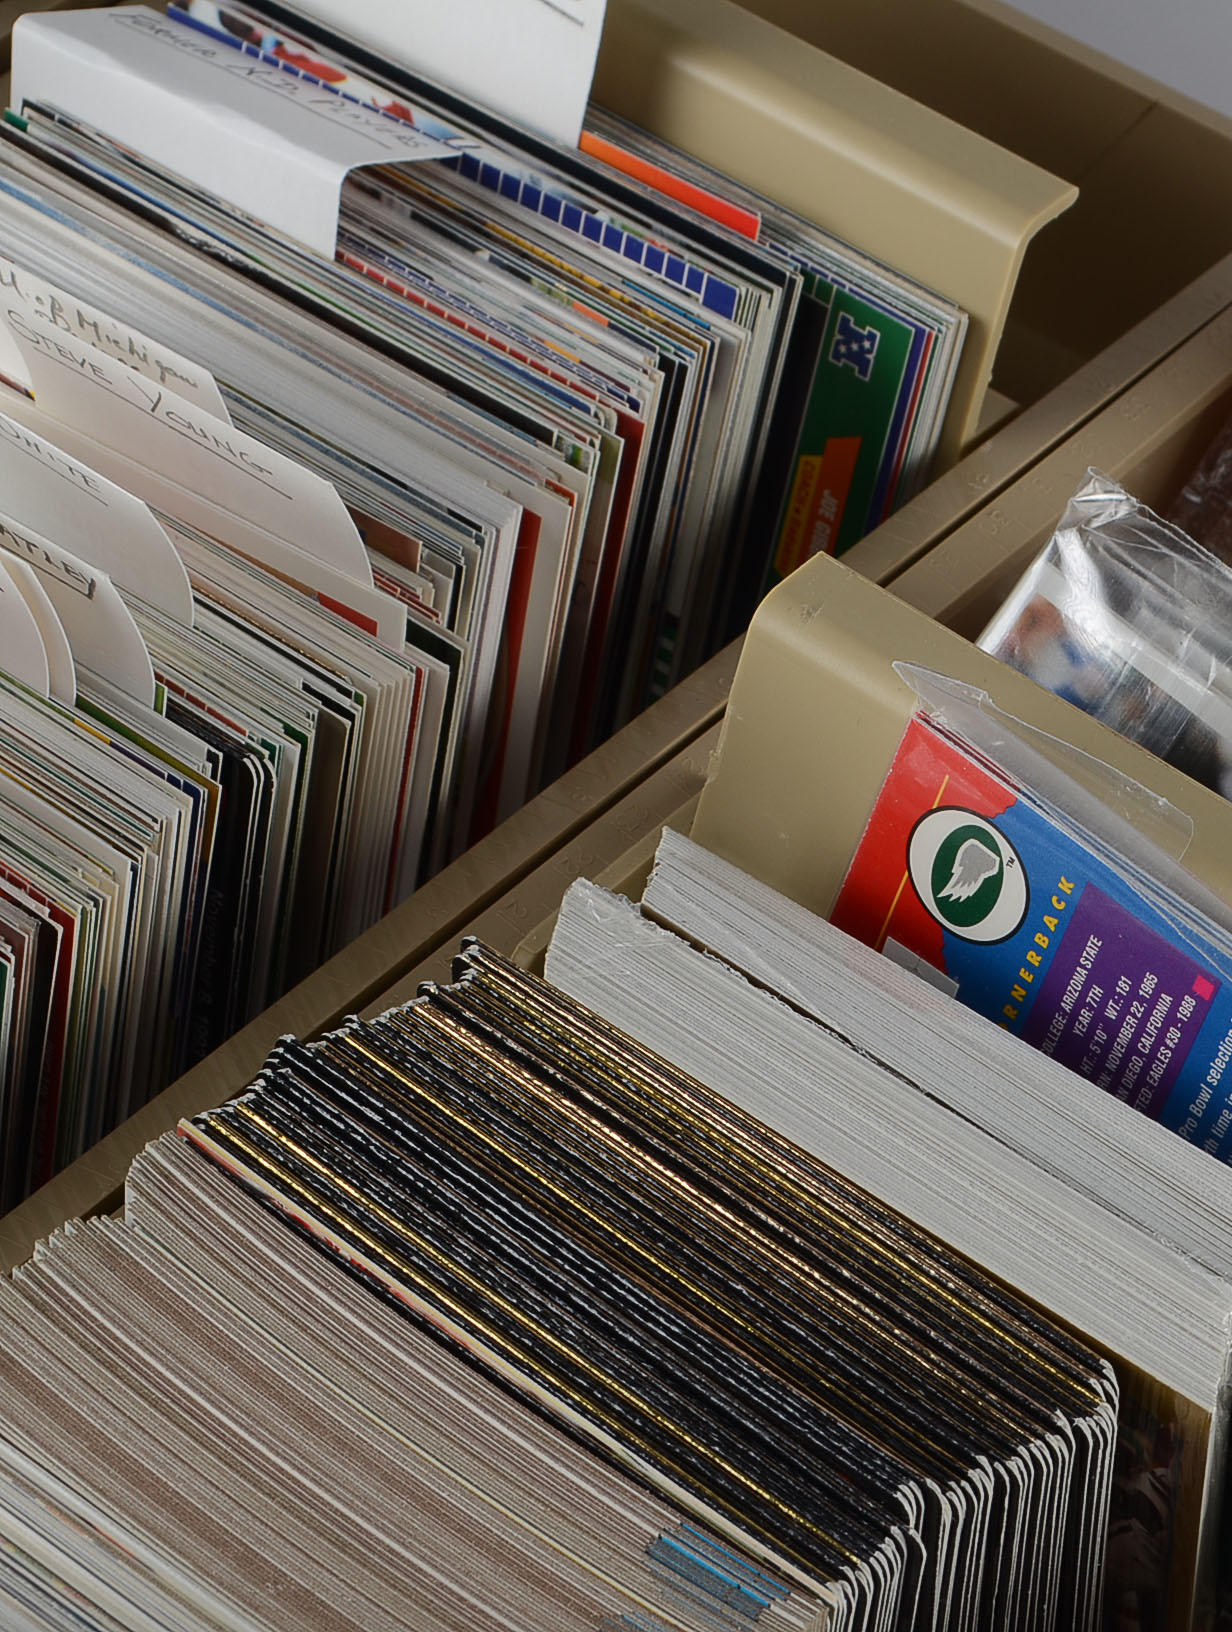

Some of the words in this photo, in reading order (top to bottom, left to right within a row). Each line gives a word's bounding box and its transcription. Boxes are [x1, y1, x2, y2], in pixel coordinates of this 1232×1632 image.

[76, 308, 199, 389] Michigan
[7, 308, 113, 385] STEVE
[126, 375, 274, 476] YOUNG
[1060, 965, 1089, 1014] ARIZONA
[1080, 934, 1103, 969] STATE
[1104, 994, 1124, 1021] WT.:
[1115, 974, 1133, 997] 181
[1138, 971, 1159, 1000] 1965
[1072, 1005, 1095, 1038] YEAR:
[1085, 983, 1104, 1008] 7TH
[1129, 1000, 1148, 1019] 22,
[1104, 1014, 1139, 1073] NOVEMBER
[1121, 1055, 1147, 1089] DIEGO,
[1137, 992, 1174, 1055] CALIFORNIA
[1146, 1045, 1172, 1087] EAGLES
[1164, 1025, 1182, 1049] #30
[1176, 994, 1197, 1022] 1988
[1177, 1116, 1199, 1141] Pro
[1188, 1082, 1214, 1118] Bowl
[1203, 1137, 1220, 1154] th
